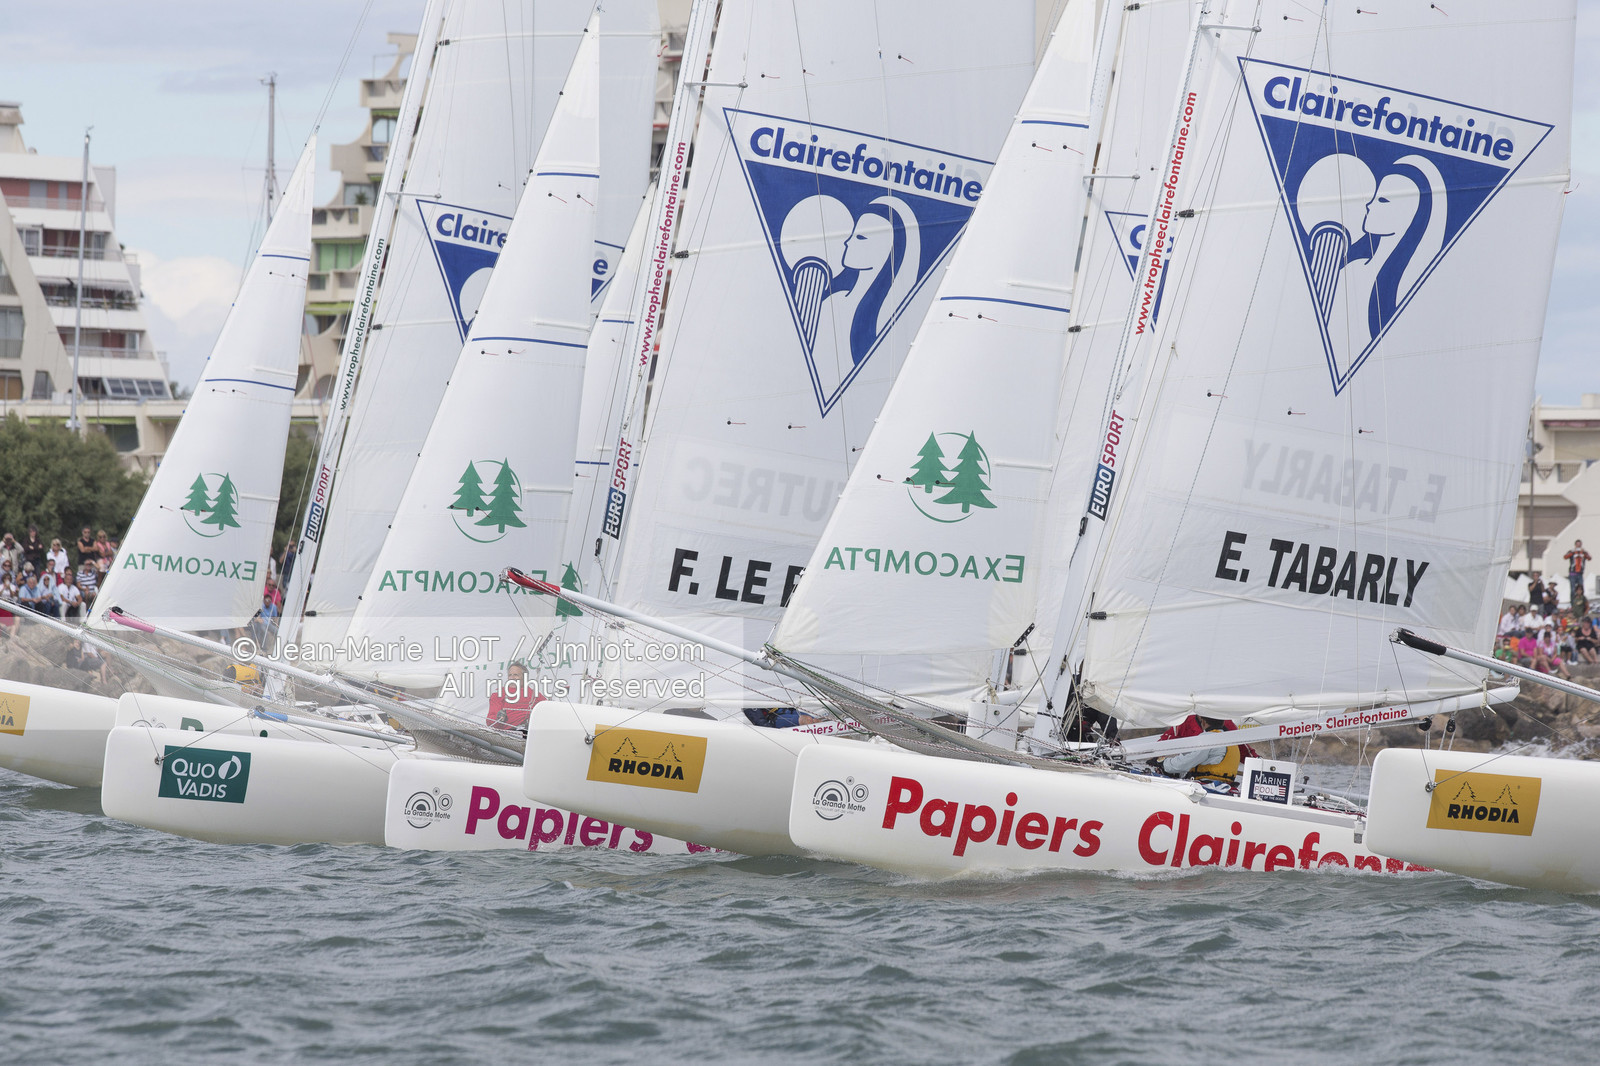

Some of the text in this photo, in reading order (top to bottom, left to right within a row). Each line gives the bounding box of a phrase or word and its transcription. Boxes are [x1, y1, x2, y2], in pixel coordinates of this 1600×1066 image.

[1264, 76, 1514, 161] Clairefontaine
[750, 127, 983, 203] Clairefontaine
[1136, 92, 1197, 335] www.tropheeclairefontaine.com
[436, 213, 507, 248] Claire
[640, 141, 686, 366] www.tropheeclairefontaine.com
[340, 238, 385, 411] www.tropheeclairefontaine.com
[667, 547, 700, 596] F.
[715, 555, 772, 605] LE
[1214, 530, 1430, 608] E. TABARLY
[1279, 708, 1408, 737] Papiers Clairefontaine
[171, 758, 215, 778] QUO
[608, 757, 684, 780] RHODIA
[1254, 774, 1288, 786] MARINE
[177, 778, 227, 798] VADIS
[1254, 786, 1274, 795] POOL
[412, 809, 434, 818] Grande
[435, 811, 451, 820] Motte
[822, 799, 846, 809] Grande
[847, 802, 866, 812] Motte
[883, 776, 1100, 857] Papiers
[1447, 803, 1520, 824] RHODIA
